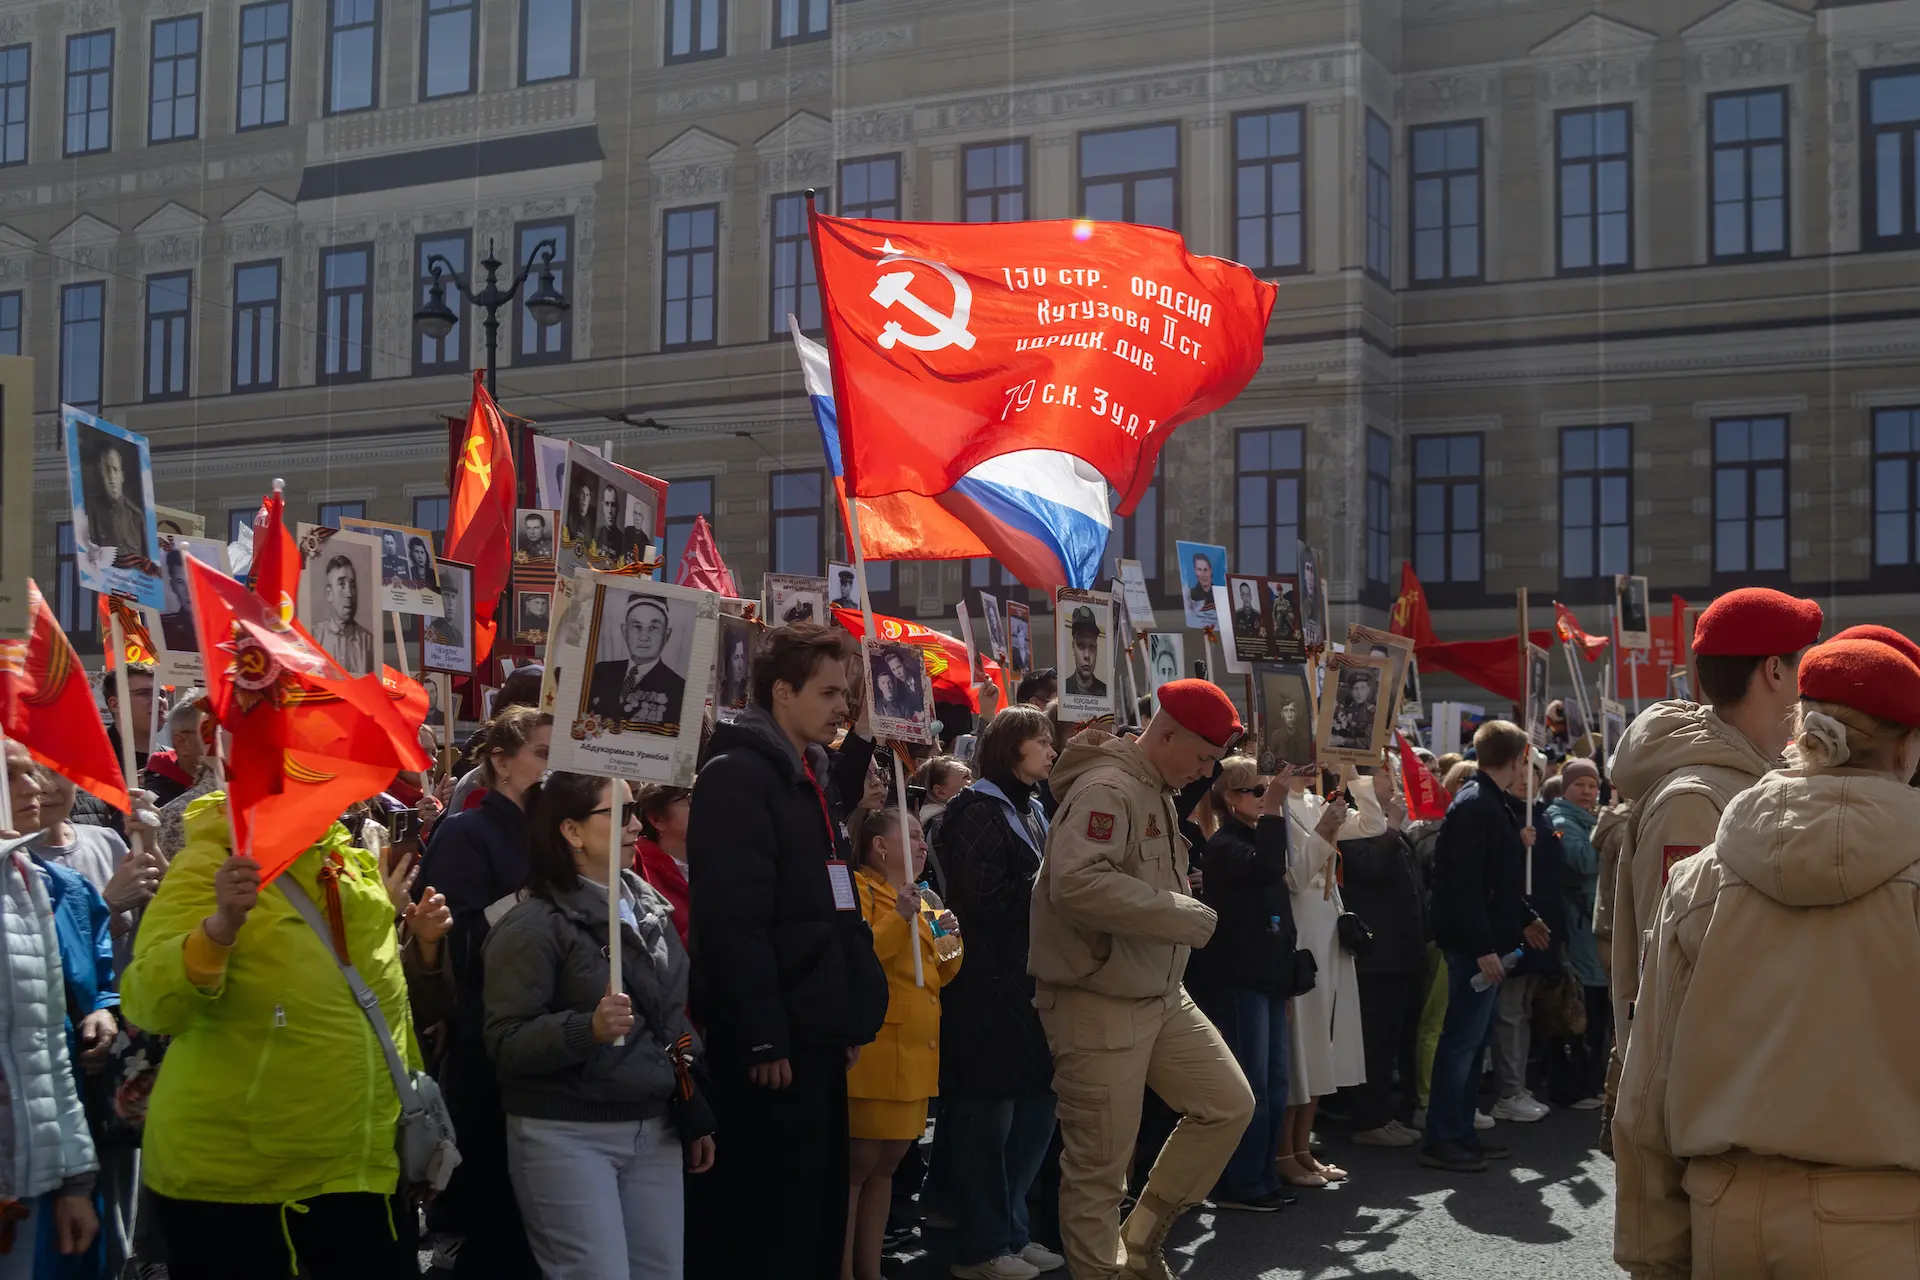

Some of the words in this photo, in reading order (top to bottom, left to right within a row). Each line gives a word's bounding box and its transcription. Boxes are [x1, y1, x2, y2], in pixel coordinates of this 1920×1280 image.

[1001, 266, 1047, 292] 150
[1059, 268, 1108, 289] СТР.
[1131, 275, 1213, 328] ОРДЕНА
[1001, 379, 1036, 421] 79
[580, 743, 635, 757] Абдукаримов
[636, 750, 670, 761] Уринбой
